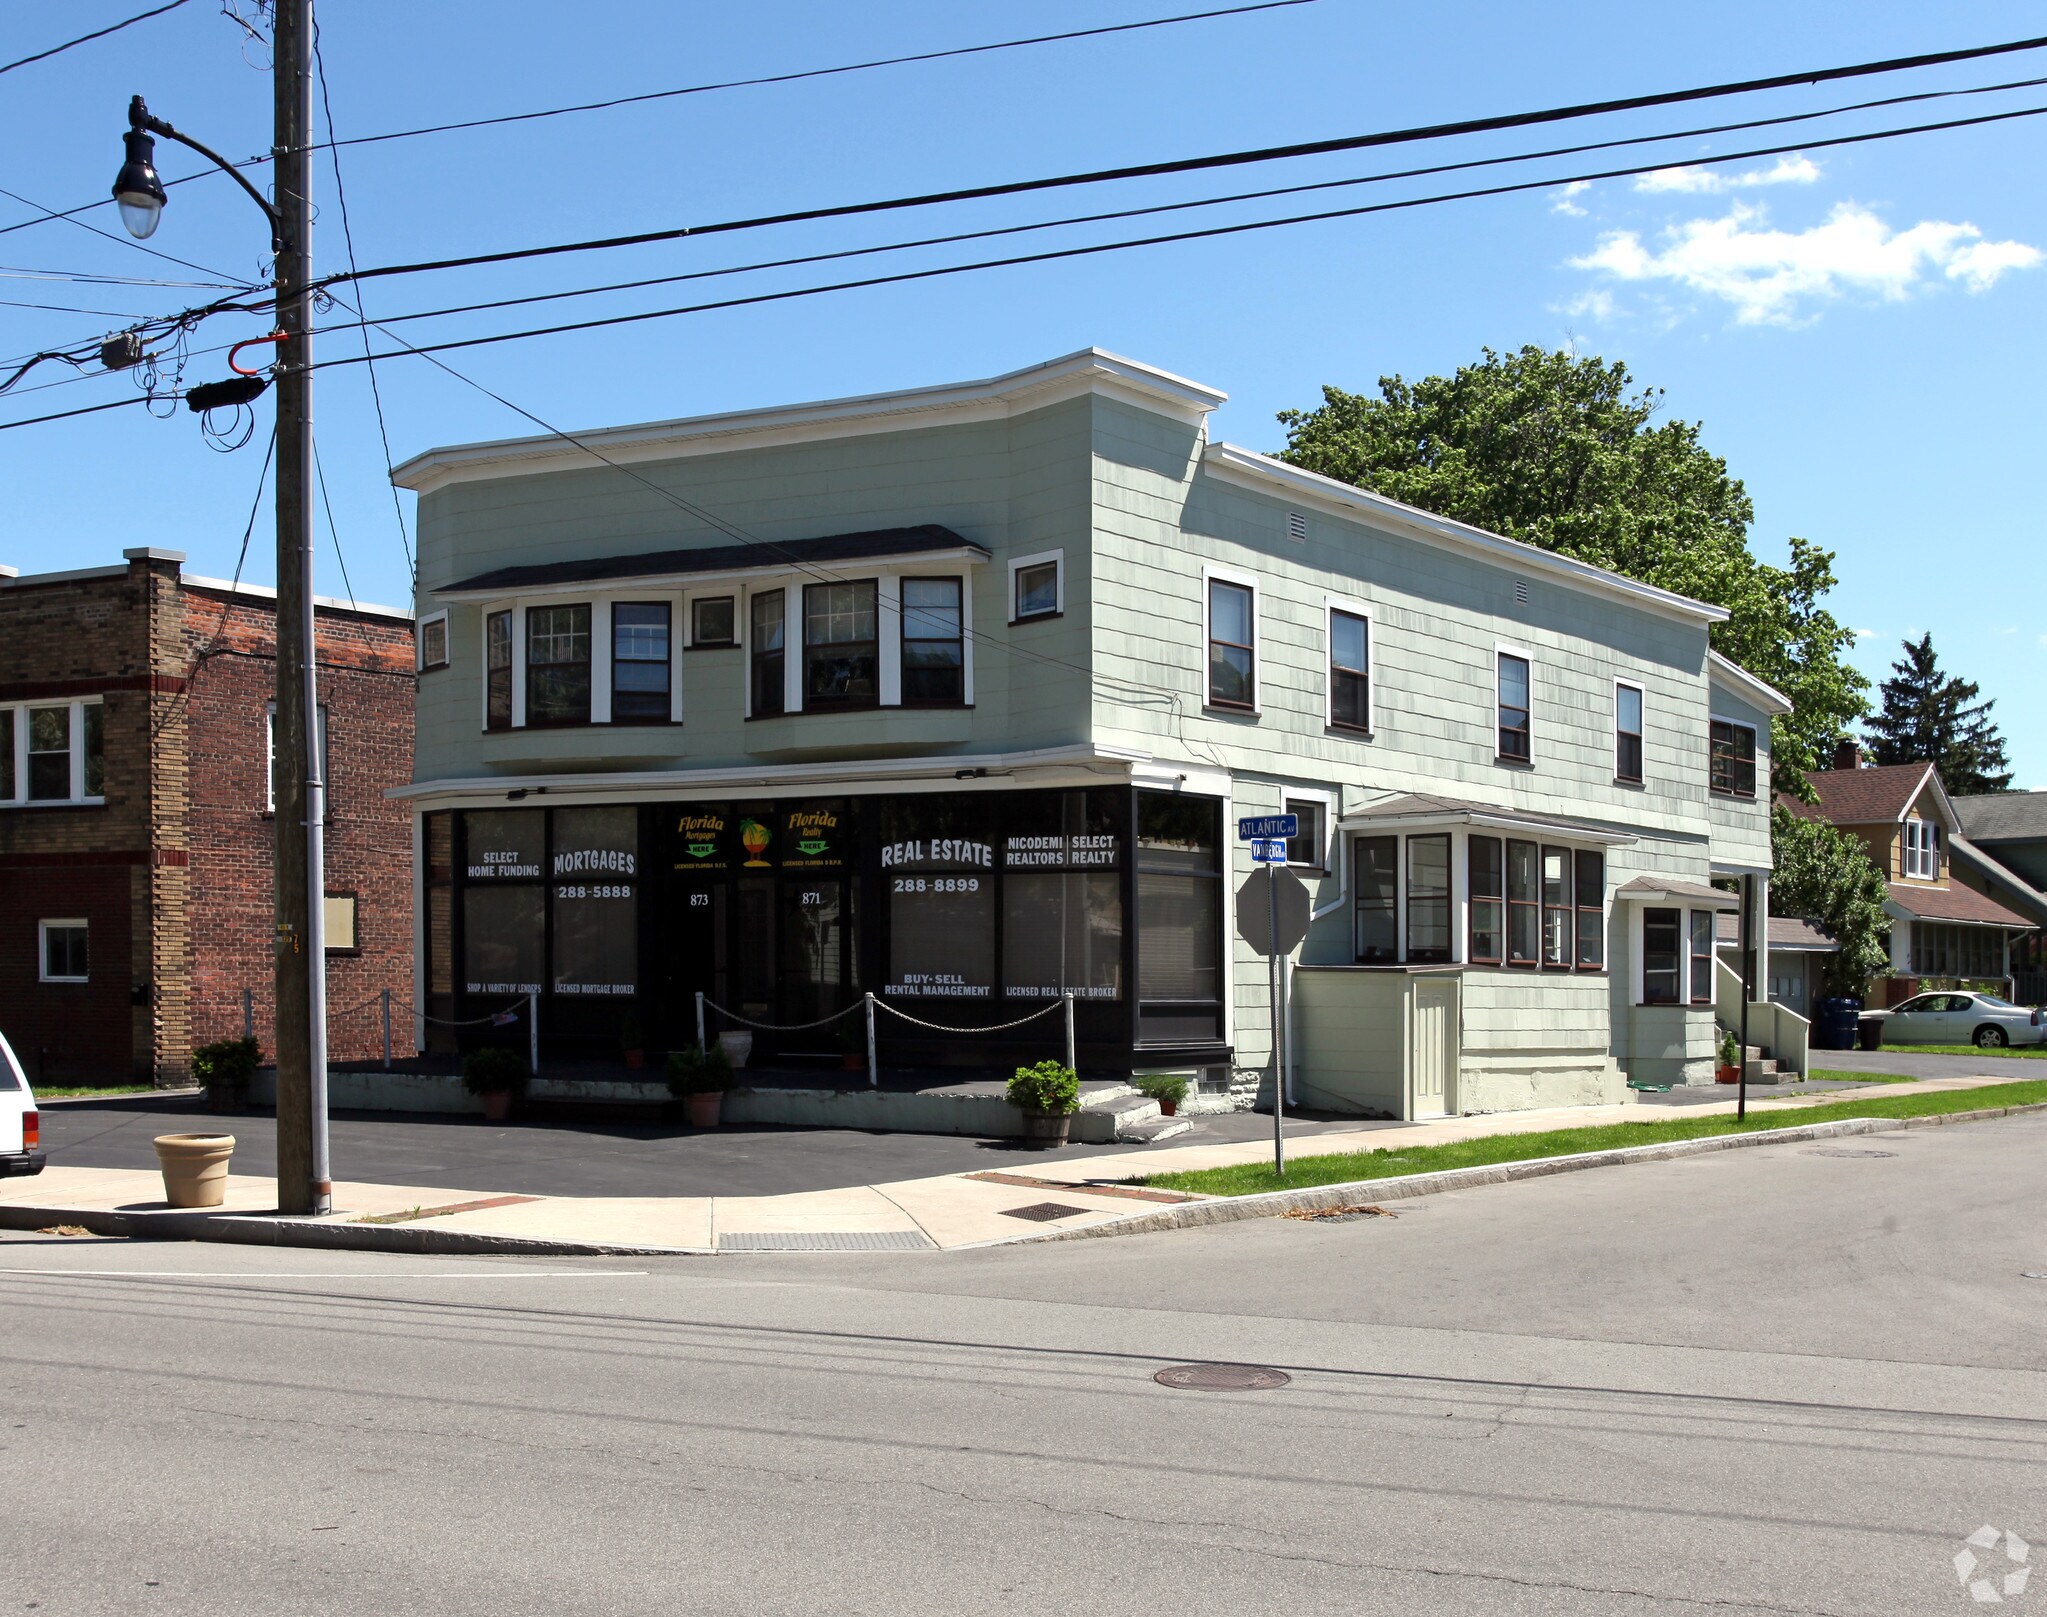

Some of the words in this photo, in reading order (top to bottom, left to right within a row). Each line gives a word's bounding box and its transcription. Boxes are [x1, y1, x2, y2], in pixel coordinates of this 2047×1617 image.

[678, 814, 724, 832] Florida
[788, 811, 837, 829] Florida
[802, 827, 822, 838] Realty
[1240, 820, 1286, 836] ATLANTIC
[1287, 825, 1295, 833] AV
[685, 831, 716, 841] Mortgages
[1072, 835, 1114, 849] SELECT
[1008, 836, 1063, 850] NICODEMI
[483, 852, 519, 864] SELECT
[881, 840, 924, 868] REAL
[931, 839, 992, 868] ESTATE
[1006, 852, 1064, 865] REALTORS
[1072, 851, 1115, 864] REALTY
[554, 850, 635, 875] MORTGAGES
[468, 866, 495, 877] HOME
[498, 865, 540, 877] FUNDING
[894, 878, 979, 893] 288-8899
[558, 886, 631, 898] 288-5888
[802, 892, 821, 904] 871
[690, 894, 709, 906] 873
[467, 983, 481, 993] SHOP
[482, 983, 487, 993] A
[487, 983, 509, 993] VARIETY
[509, 984, 517, 993] OF
[518, 984, 542, 994] LENDERS
[555, 983, 580, 993] LICENSED
[581, 984, 611, 994] MORTGAGE
[612, 985, 635, 995] BROKER
[884, 985, 920, 995] RENTAL
[922, 986, 990, 996] MANAGEMENT
[1006, 987, 1039, 997] LICENSED
[1041, 987, 1059, 997] REAL
[1061, 987, 1086, 997] ESTATE
[1088, 987, 1117, 998] BROKER
